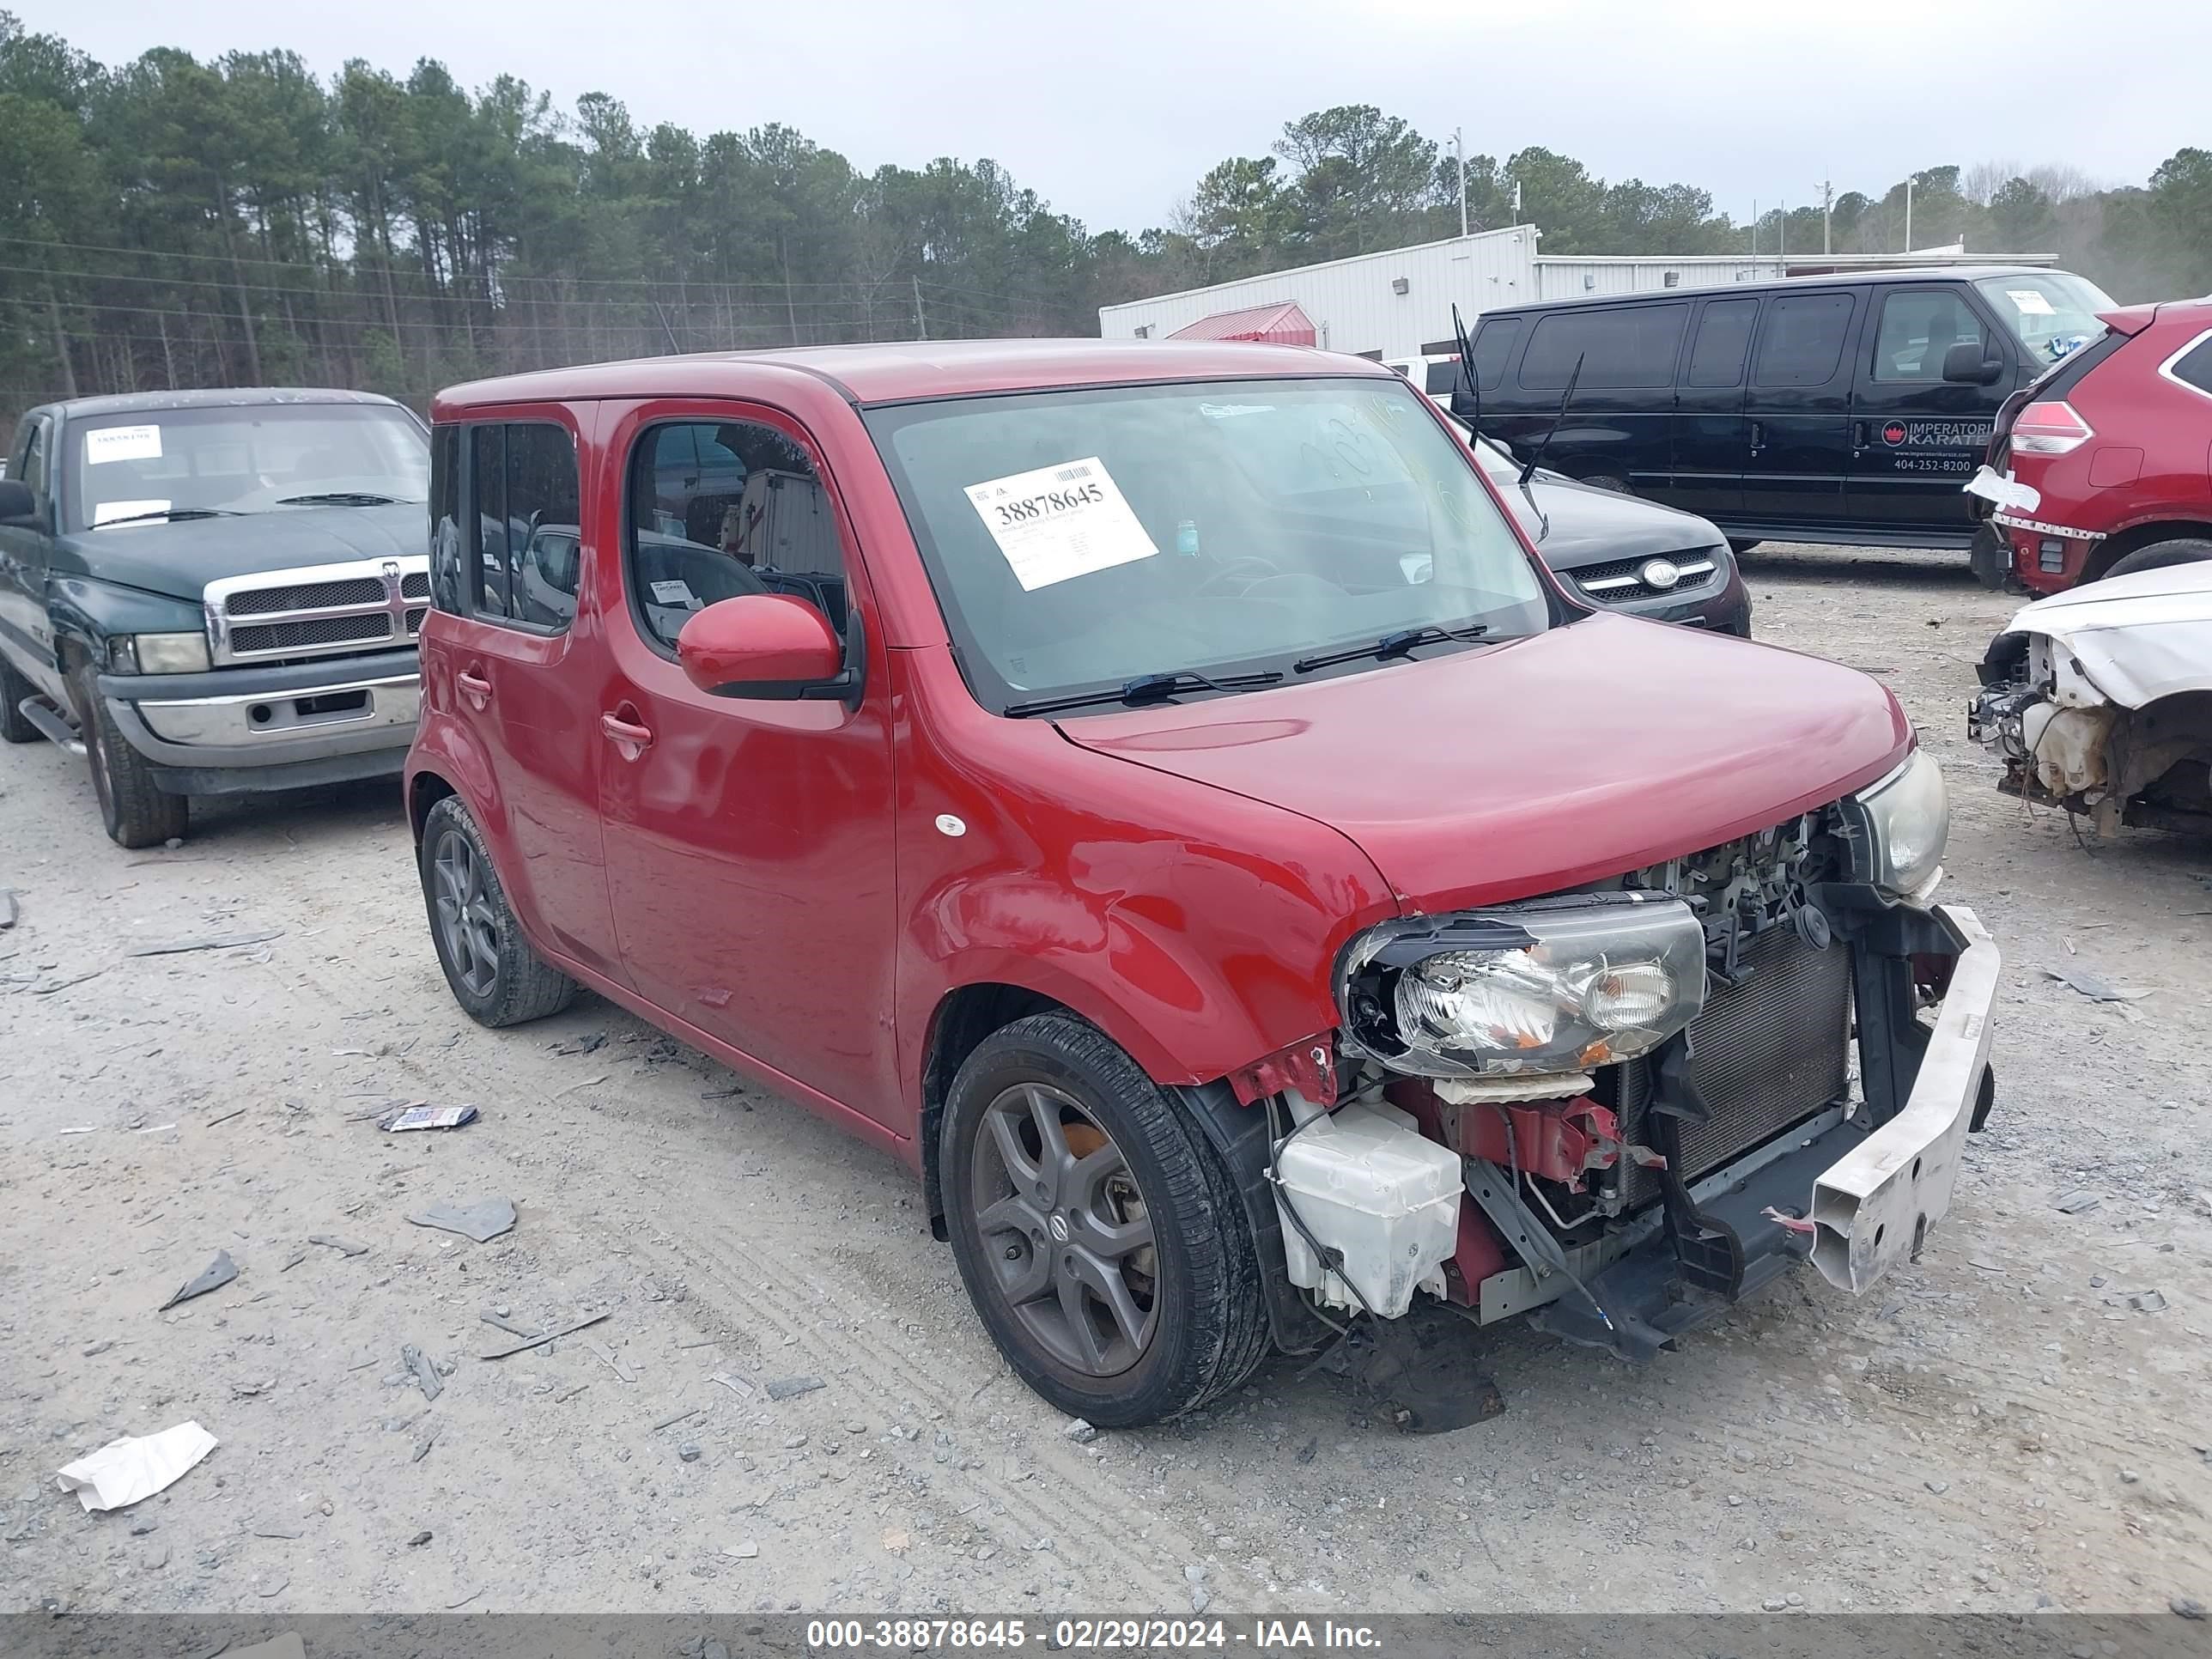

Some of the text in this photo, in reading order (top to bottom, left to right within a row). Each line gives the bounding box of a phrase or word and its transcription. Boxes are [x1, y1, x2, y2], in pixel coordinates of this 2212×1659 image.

[1909, 422, 1991, 434] IMPERATORI
[1908, 434, 1989, 445] KARATE
[1894, 459, 1971, 471] 404-252-8200
[995, 483, 1103, 525] 38878645
